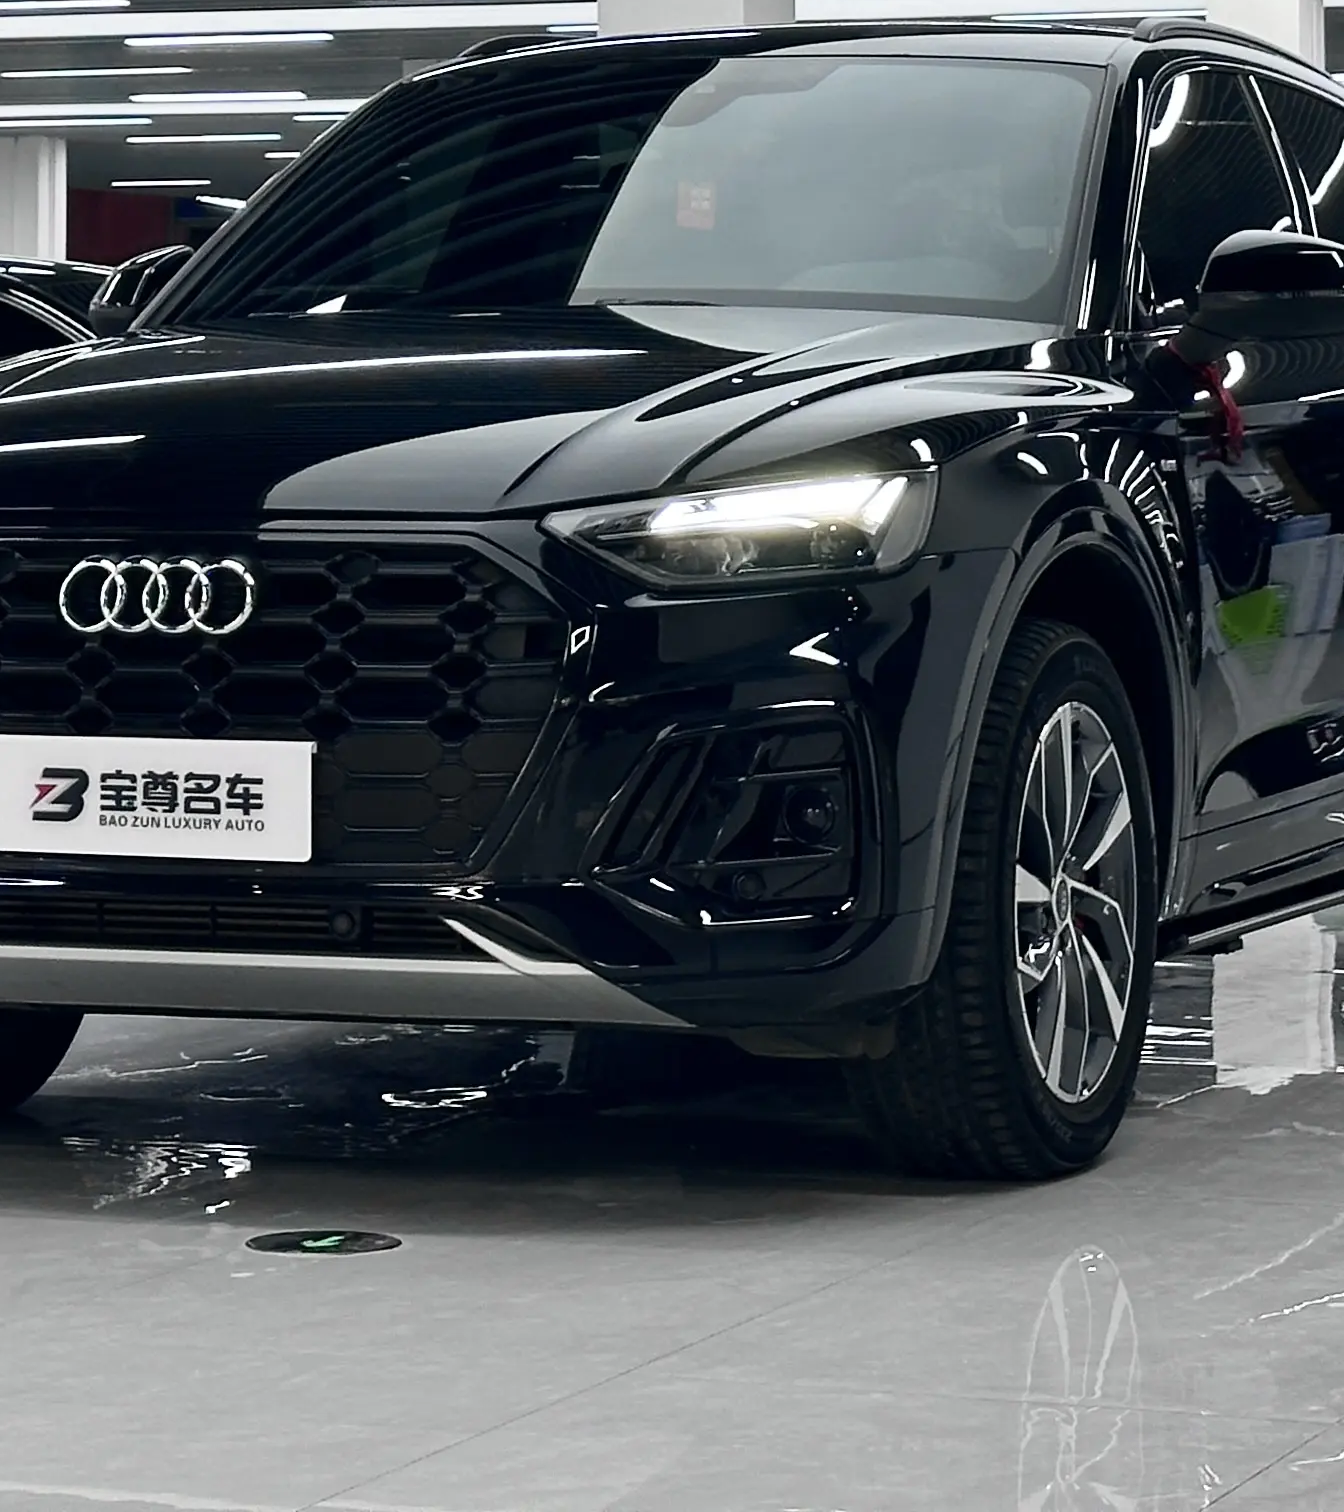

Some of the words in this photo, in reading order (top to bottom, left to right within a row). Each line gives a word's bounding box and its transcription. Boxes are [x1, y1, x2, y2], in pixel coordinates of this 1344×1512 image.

[99, 769, 264, 816] 宝尊名车
[99, 815, 128, 827] BAO
[131, 816, 160, 829] ZUN
[164, 817, 221, 831] LUXURY
[225, 819, 265, 832] AUTO
